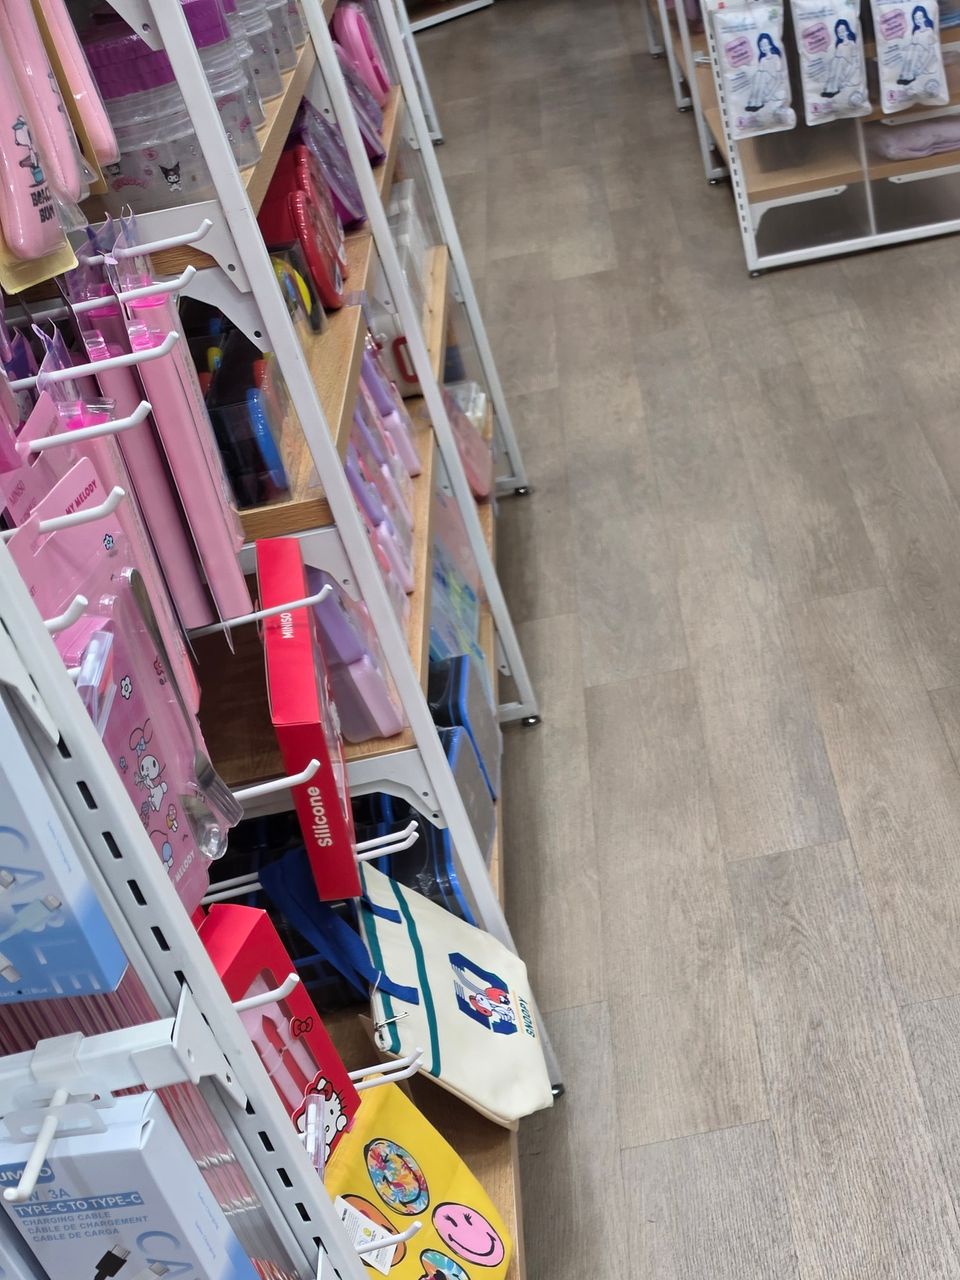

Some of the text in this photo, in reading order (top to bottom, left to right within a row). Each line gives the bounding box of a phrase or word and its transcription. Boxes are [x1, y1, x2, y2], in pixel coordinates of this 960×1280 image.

[75, 480, 97, 507] MELODY
[280, 612, 295, 639] MINISO
[48, 1188, 71, 1200] 3A
[15, 1193, 142, 1217] TYPE-C TO TYPE-C
[22, 1211, 112, 1226] CHARGING CABLE
[63, 1222, 77, 1231] DE
[79, 1215, 149, 1230] CHARGEMENT
[32, 1228, 121, 1243] CABLE DE CARGA
